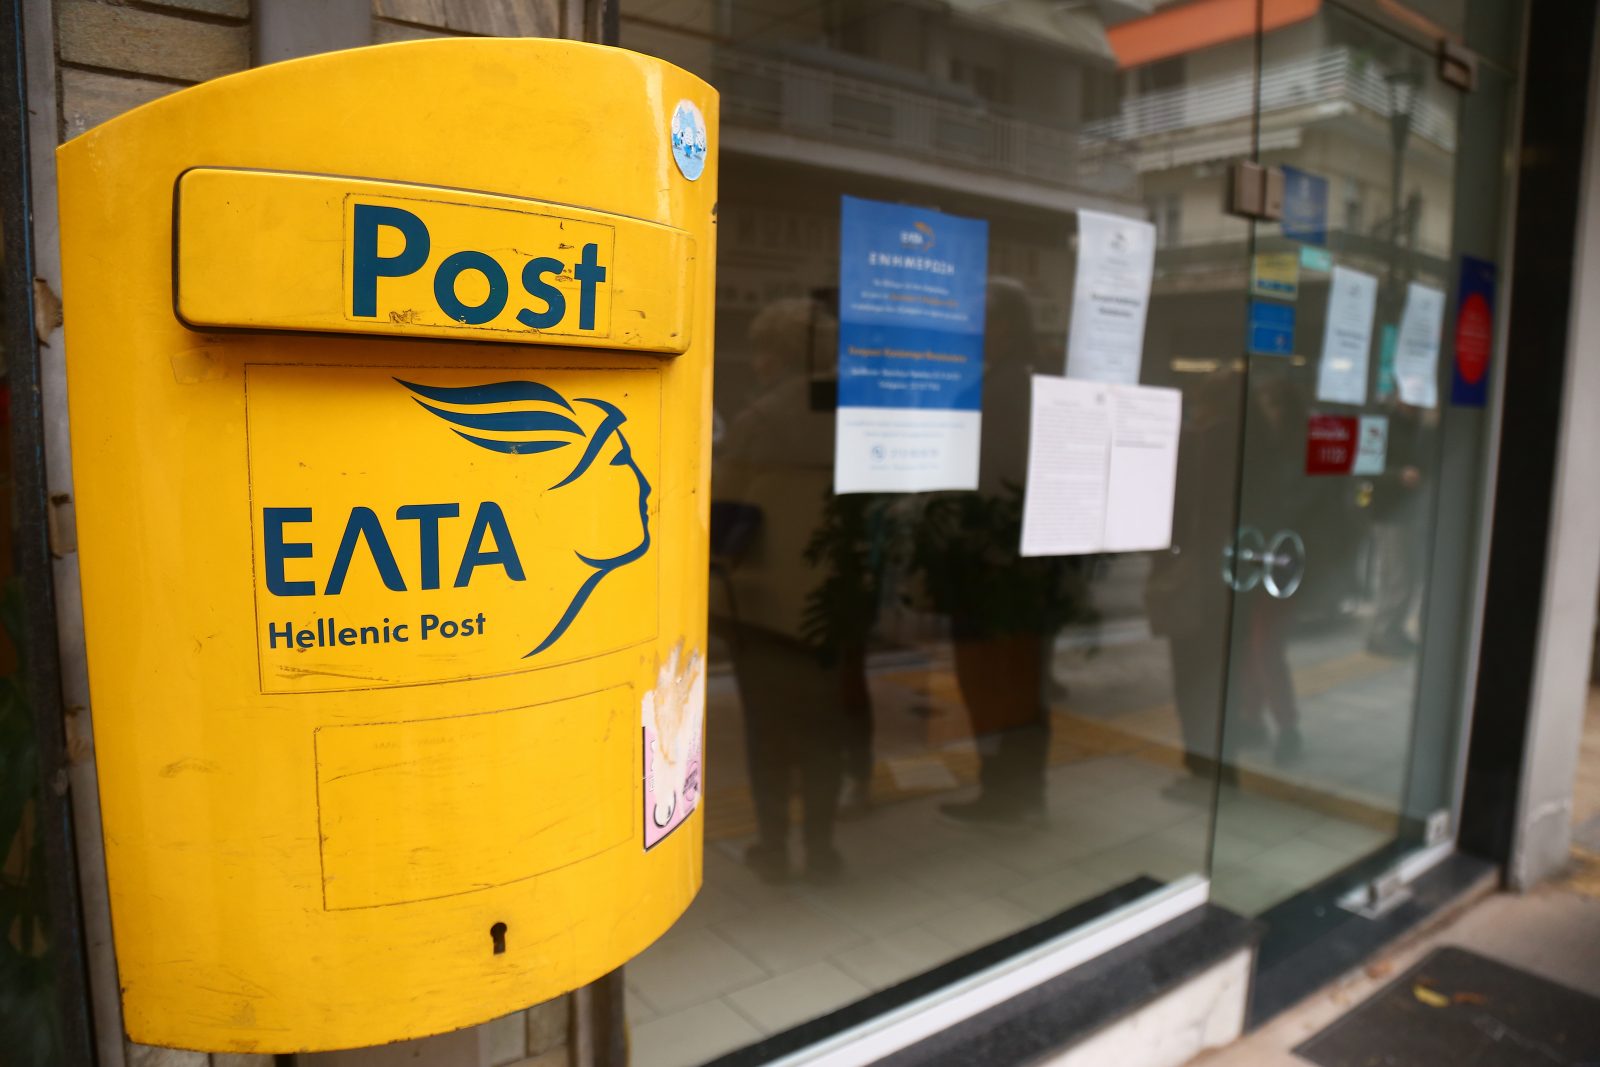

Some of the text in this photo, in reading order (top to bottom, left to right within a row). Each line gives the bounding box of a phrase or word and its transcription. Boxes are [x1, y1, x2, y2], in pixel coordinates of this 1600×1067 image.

[352, 203, 606, 331] Post
[263, 501, 527, 597] ΕΛΤΑ
[268, 612, 486, 649] Hellenic Post
